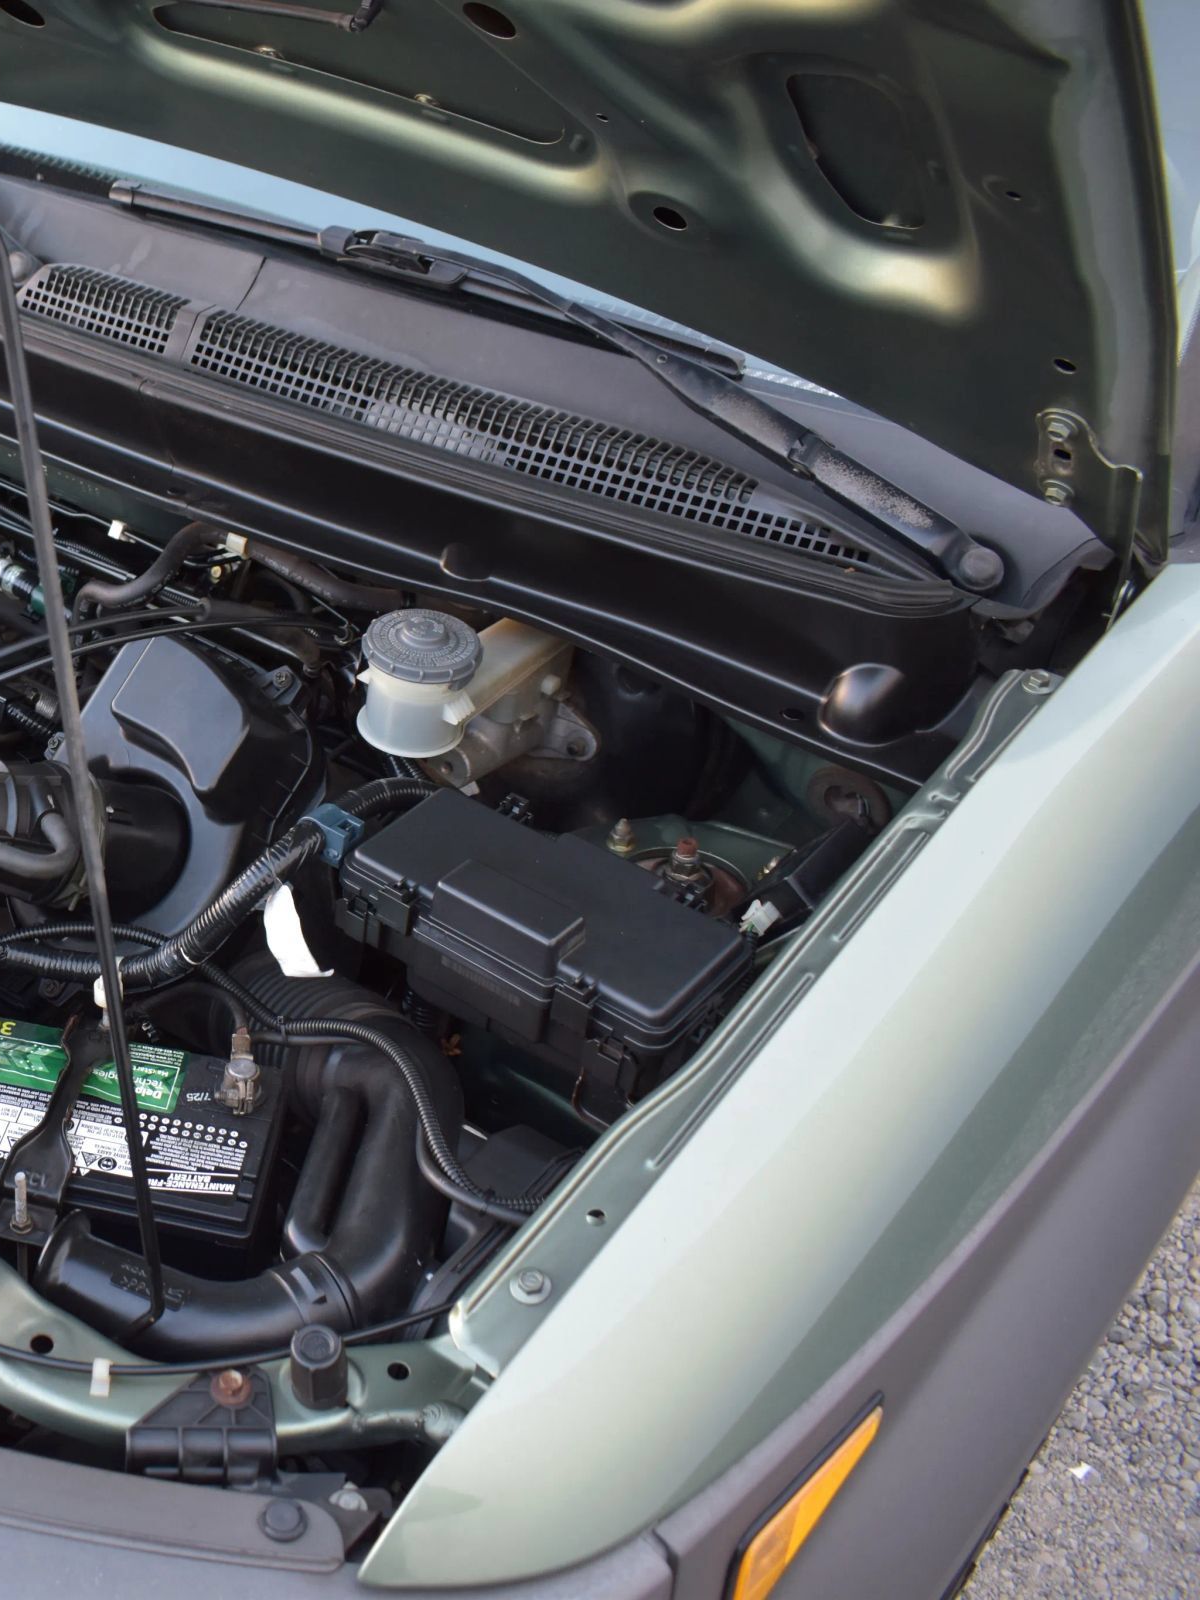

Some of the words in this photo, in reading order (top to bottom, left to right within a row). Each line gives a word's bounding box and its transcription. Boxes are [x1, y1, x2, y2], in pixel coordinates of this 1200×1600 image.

[133, 1085, 162, 1099] Delp
[146, 1178, 235, 1192] MAINTENANCE-FR
[166, 1173, 211, 1183] BATTERY
